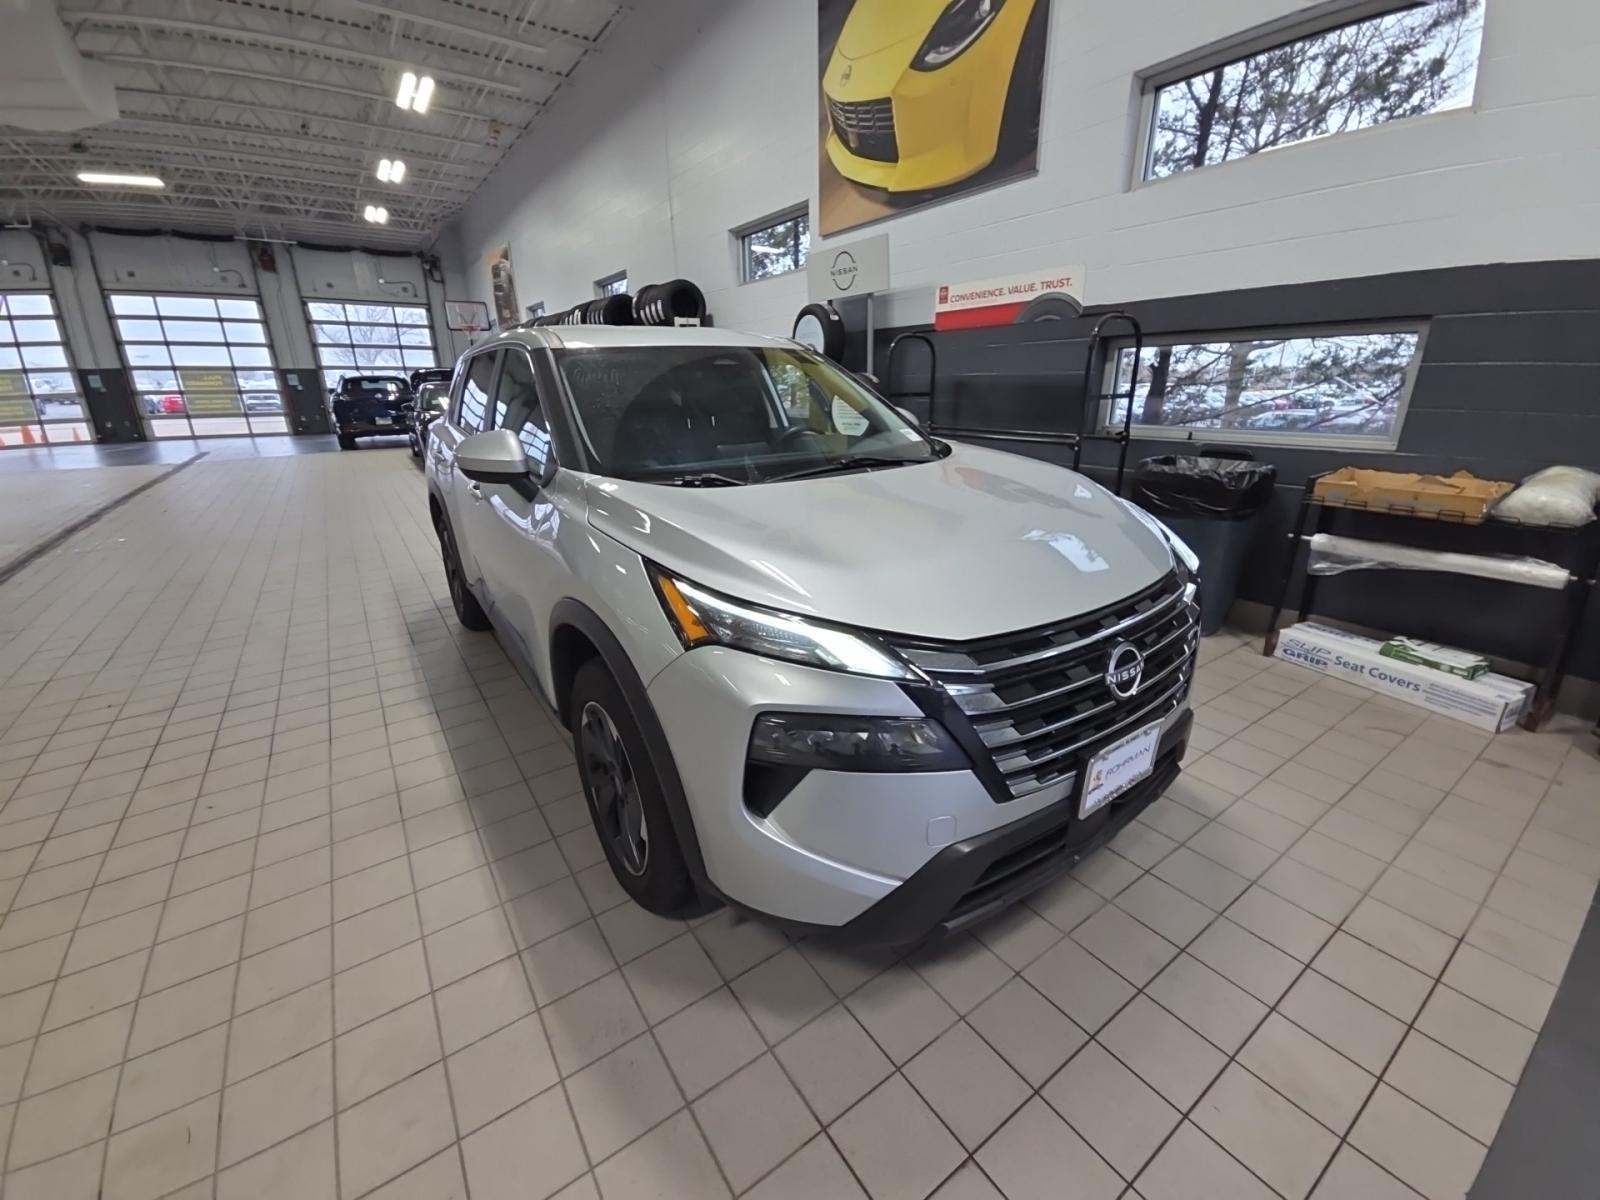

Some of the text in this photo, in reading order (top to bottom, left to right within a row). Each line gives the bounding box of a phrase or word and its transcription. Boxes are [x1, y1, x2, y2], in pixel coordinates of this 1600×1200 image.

[831, 266, 858, 276] NISSAN
[949, 287, 1006, 303] CONVENIENCE.
[1008, 282, 1038, 295] VALUE.
[1041, 277, 1073, 291] TRUST.
[1288, 639, 1332, 655] SLIP
[1282, 648, 1329, 667] GRIP
[1334, 655, 1421, 692] Seat Covers
